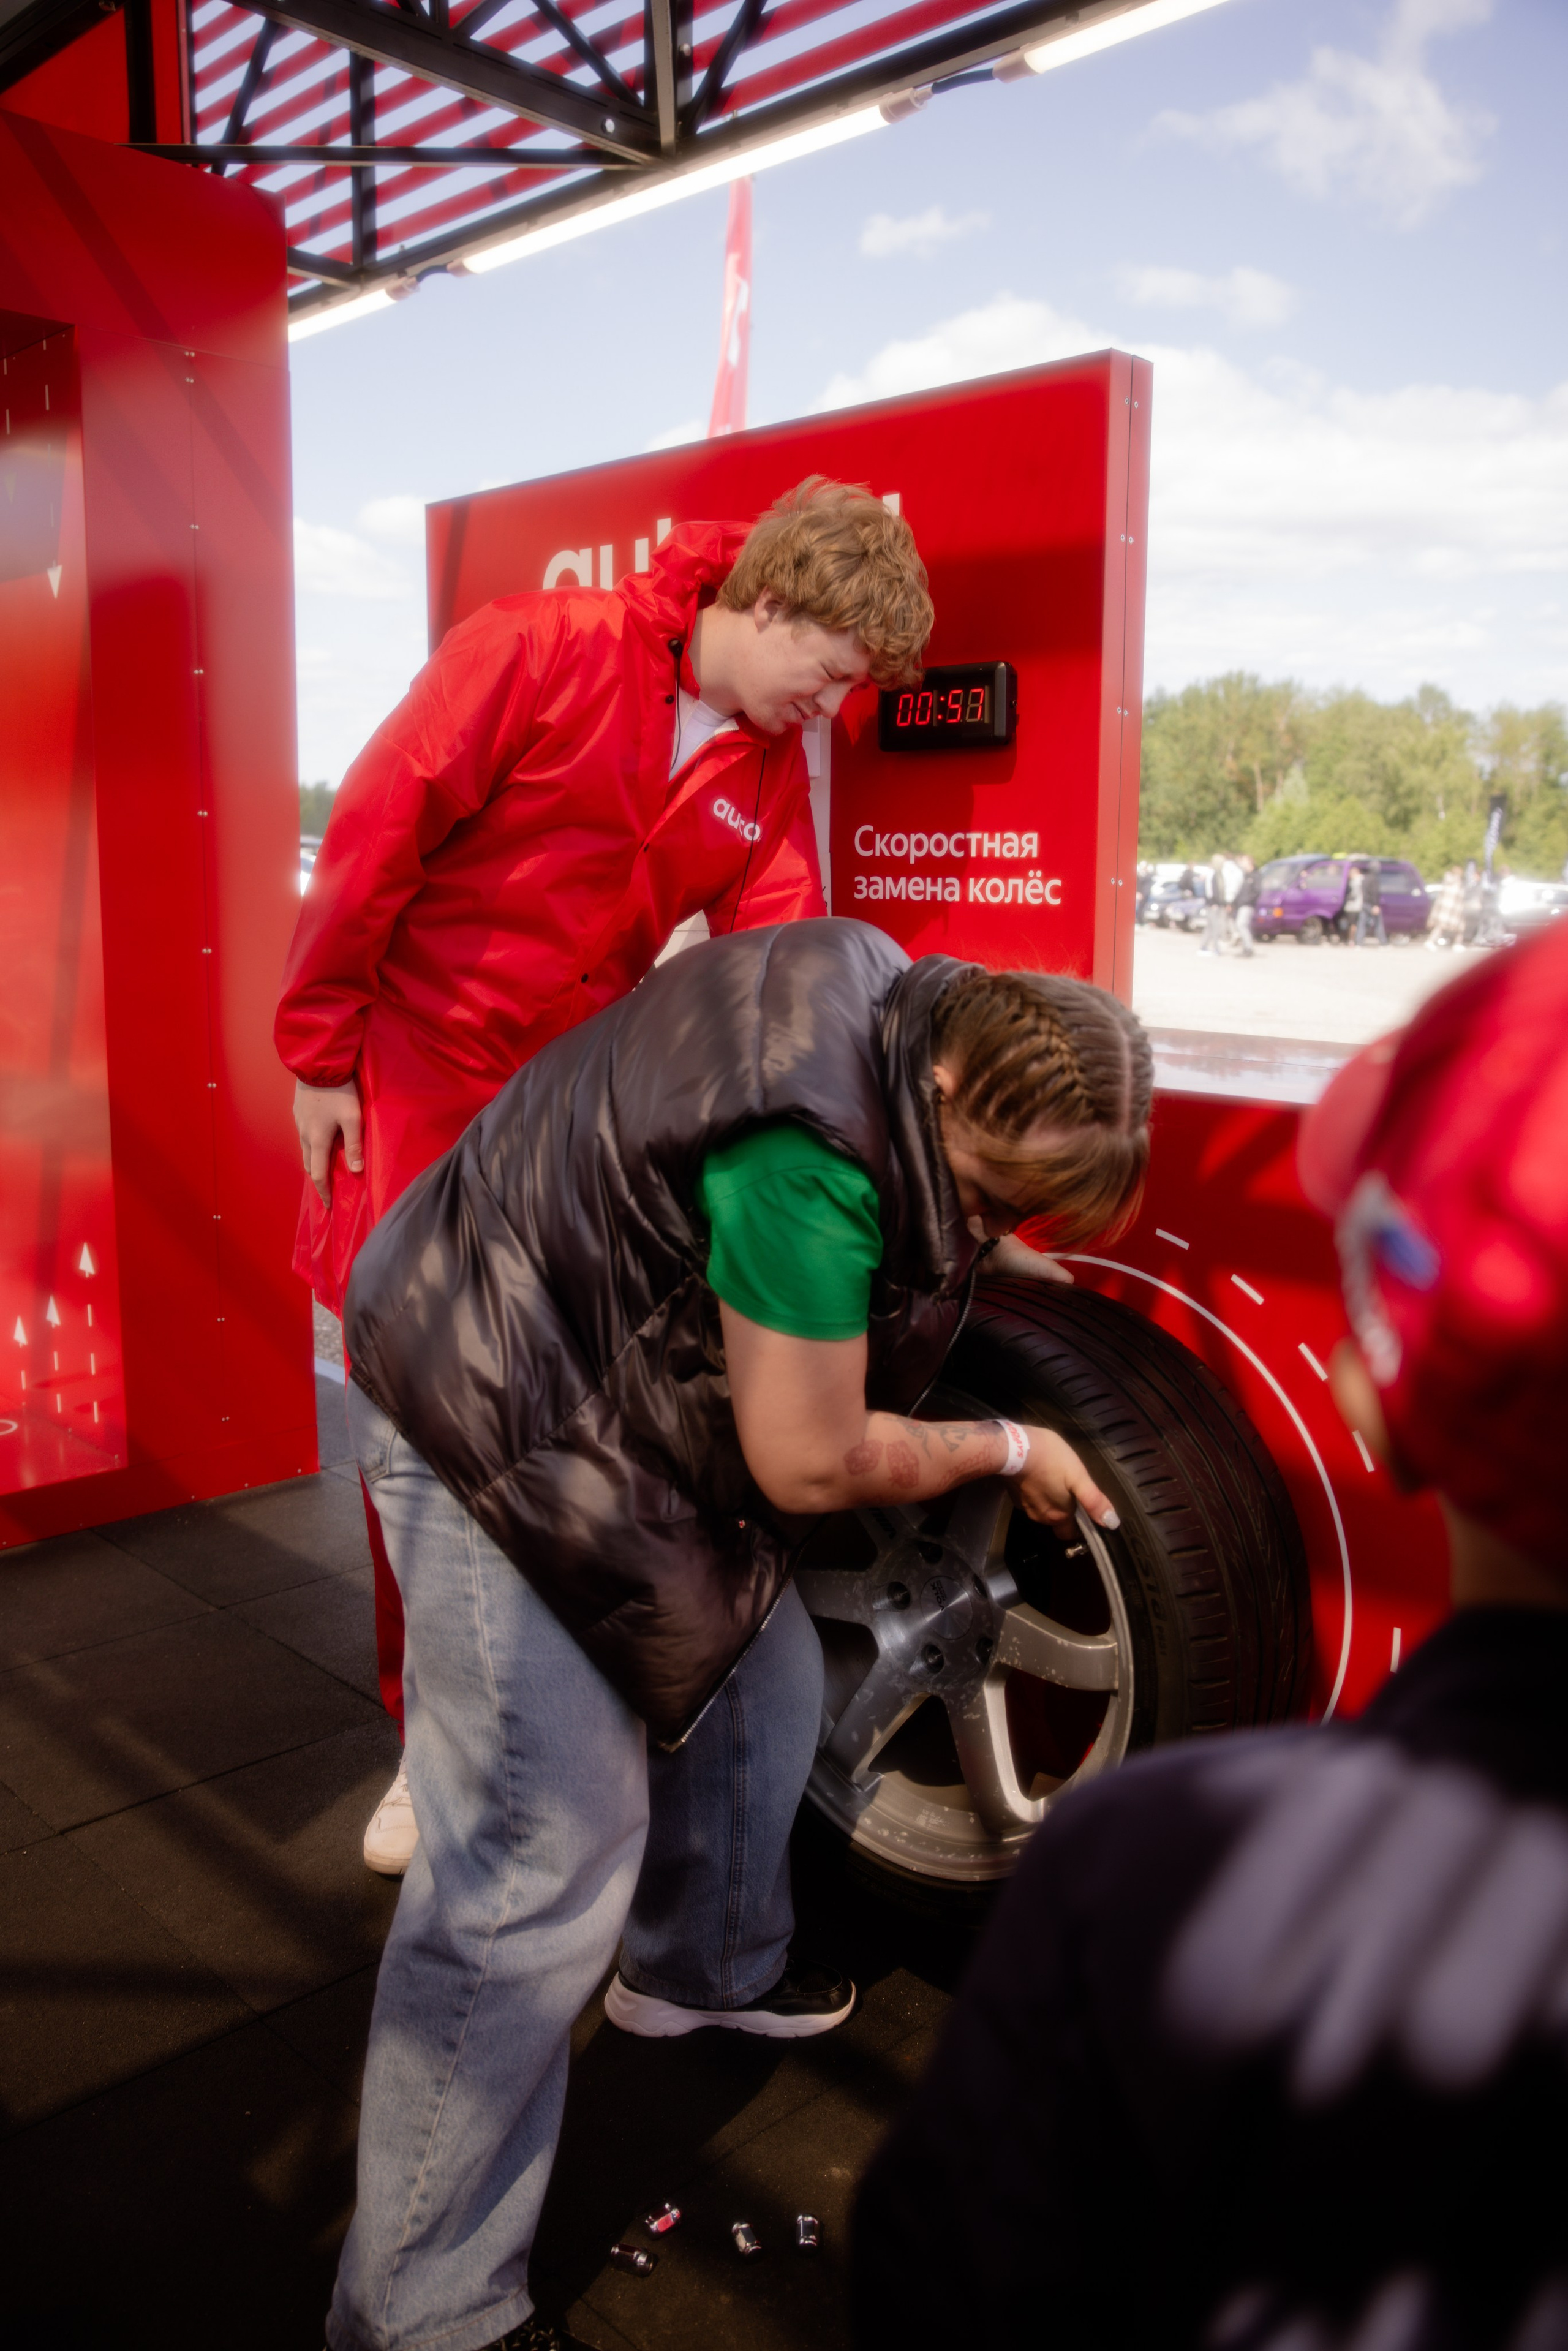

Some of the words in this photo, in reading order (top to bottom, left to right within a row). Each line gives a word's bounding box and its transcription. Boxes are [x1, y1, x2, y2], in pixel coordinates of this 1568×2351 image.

[897, 688, 984, 727] 00:57
[854, 825, 1038, 864] Скоростная
[854, 875, 960, 902] замена
[968, 870, 1061, 905] колёс
[930, 1582, 944, 1611] VOLK
